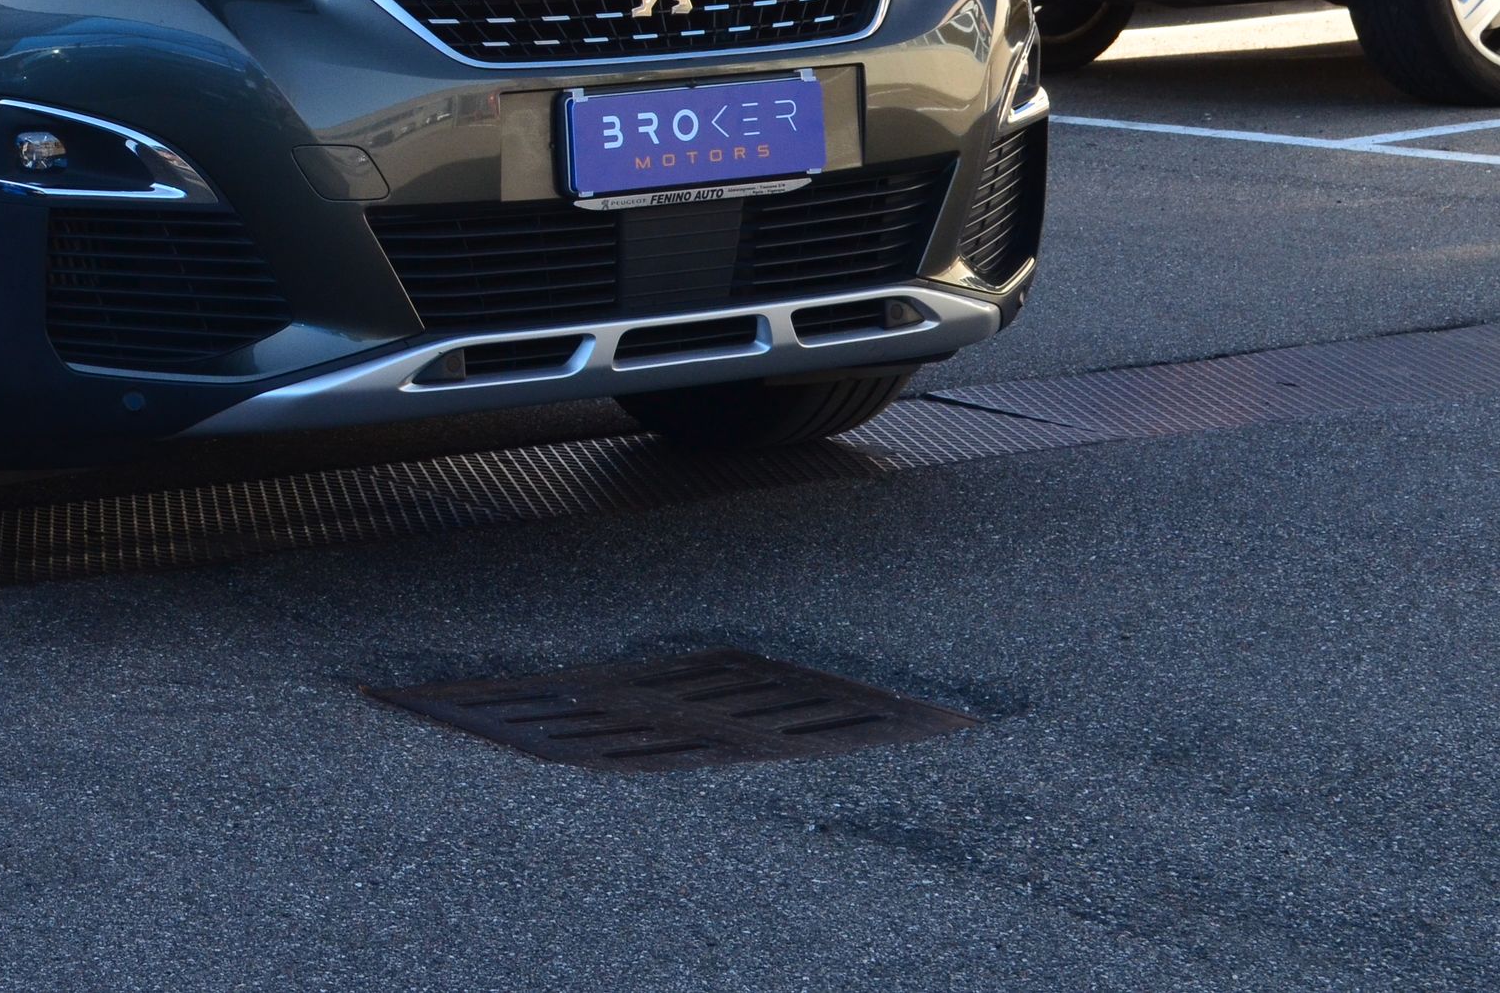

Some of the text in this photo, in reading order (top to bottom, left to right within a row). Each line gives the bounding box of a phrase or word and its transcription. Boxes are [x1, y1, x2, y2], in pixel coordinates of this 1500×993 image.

[602, 99, 798, 149] BROKER
[635, 144, 771, 169] MOTORS
[610, 188, 724, 206] PEUGEOT FENINO AUTO
